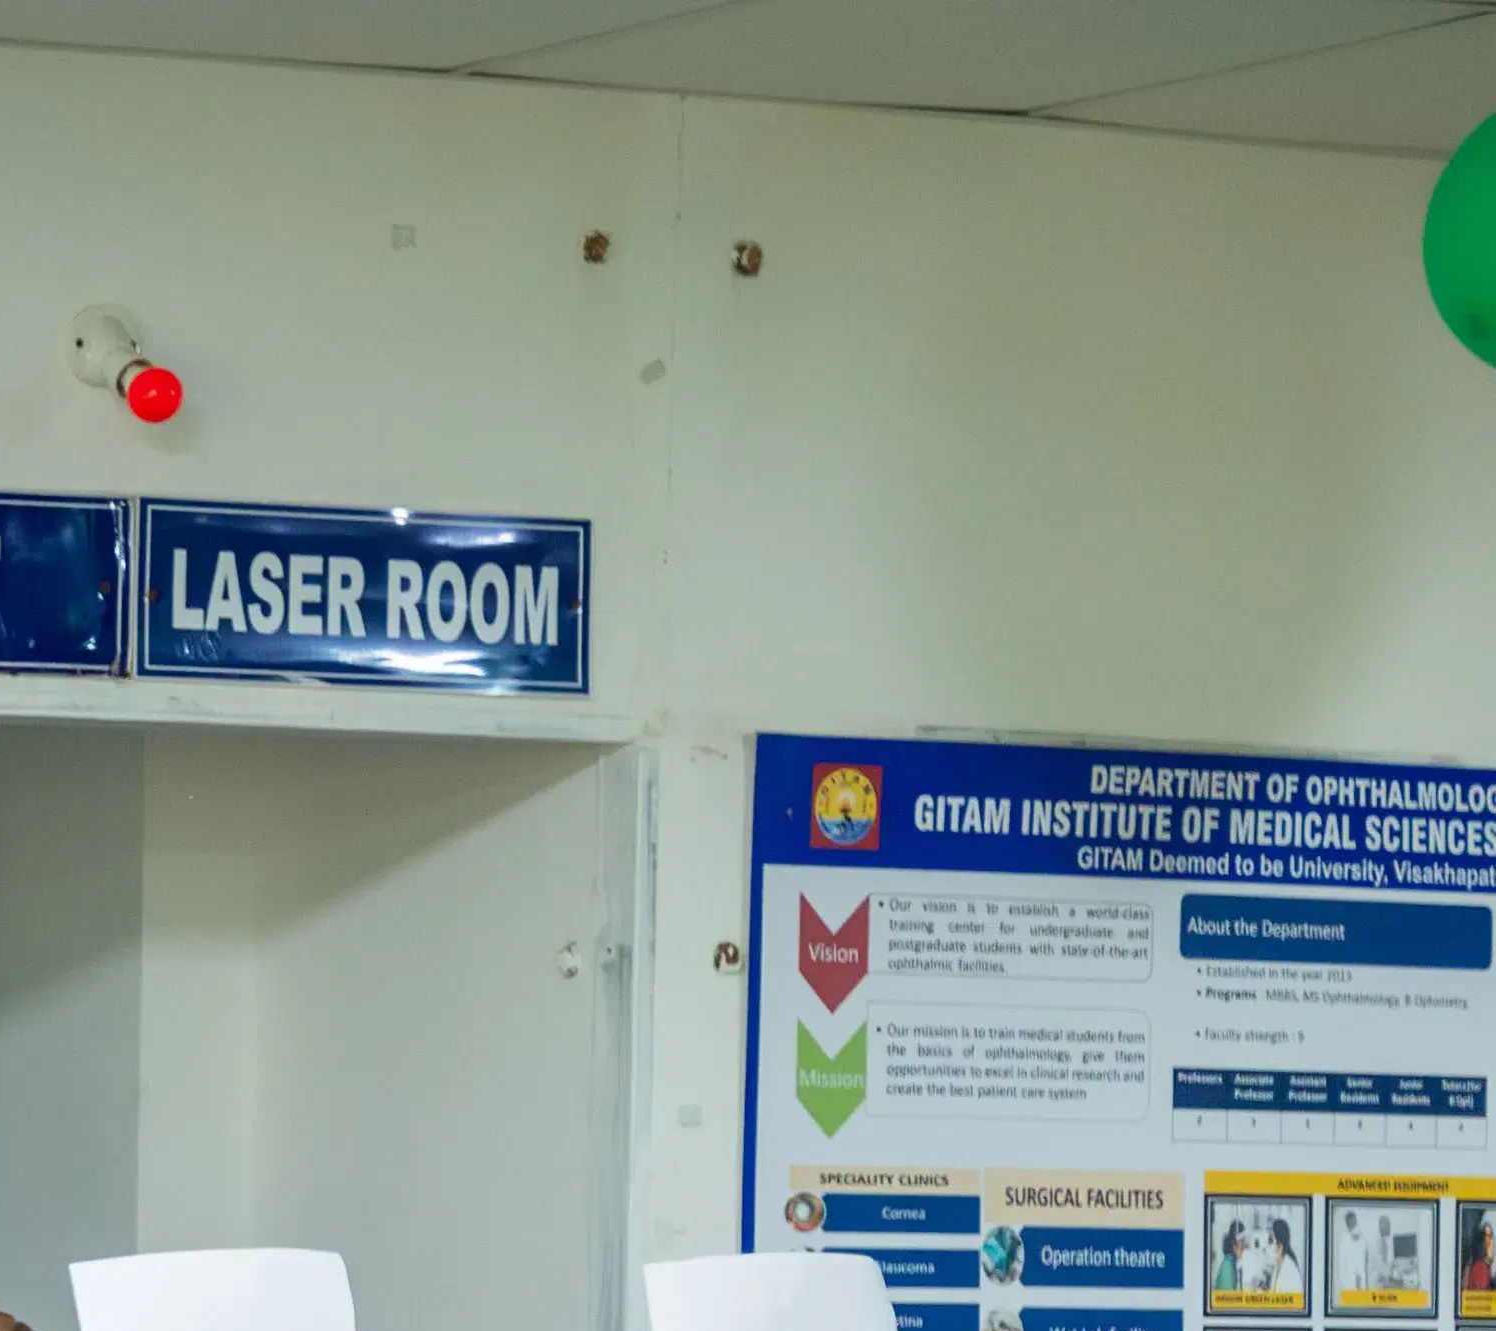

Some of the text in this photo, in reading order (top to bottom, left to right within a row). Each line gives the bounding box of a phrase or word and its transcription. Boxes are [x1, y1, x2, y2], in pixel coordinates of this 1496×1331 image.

[171, 547, 559, 646] LASER ROOM
[1090, 765, 1260, 803] DEPARTMENT
[1266, 774, 1299, 804] OF
[914, 794, 1496, 857] GITAM INSTITUTE OF MEDICAL SCIENCES
[1077, 845, 1143, 872] GITAM
[1149, 847, 1228, 878] Deemed
[1232, 855, 1255, 877] to
[1258, 853, 1284, 879] be
[1289, 854, 1389, 888] University,
[1186, 916, 1346, 943] About the Department
[809, 943, 859, 964] Vision
[799, 1067, 864, 1089] Mission
[819, 1171, 950, 1188] SPECIALITY CLINICS
[1004, 1185, 1165, 1211] SURGICAL FACILITIES
[881, 1205, 927, 1221] Cornea
[880, 1259, 935, 1276] laucoma
[1041, 1244, 1166, 1271] Operation theatre
